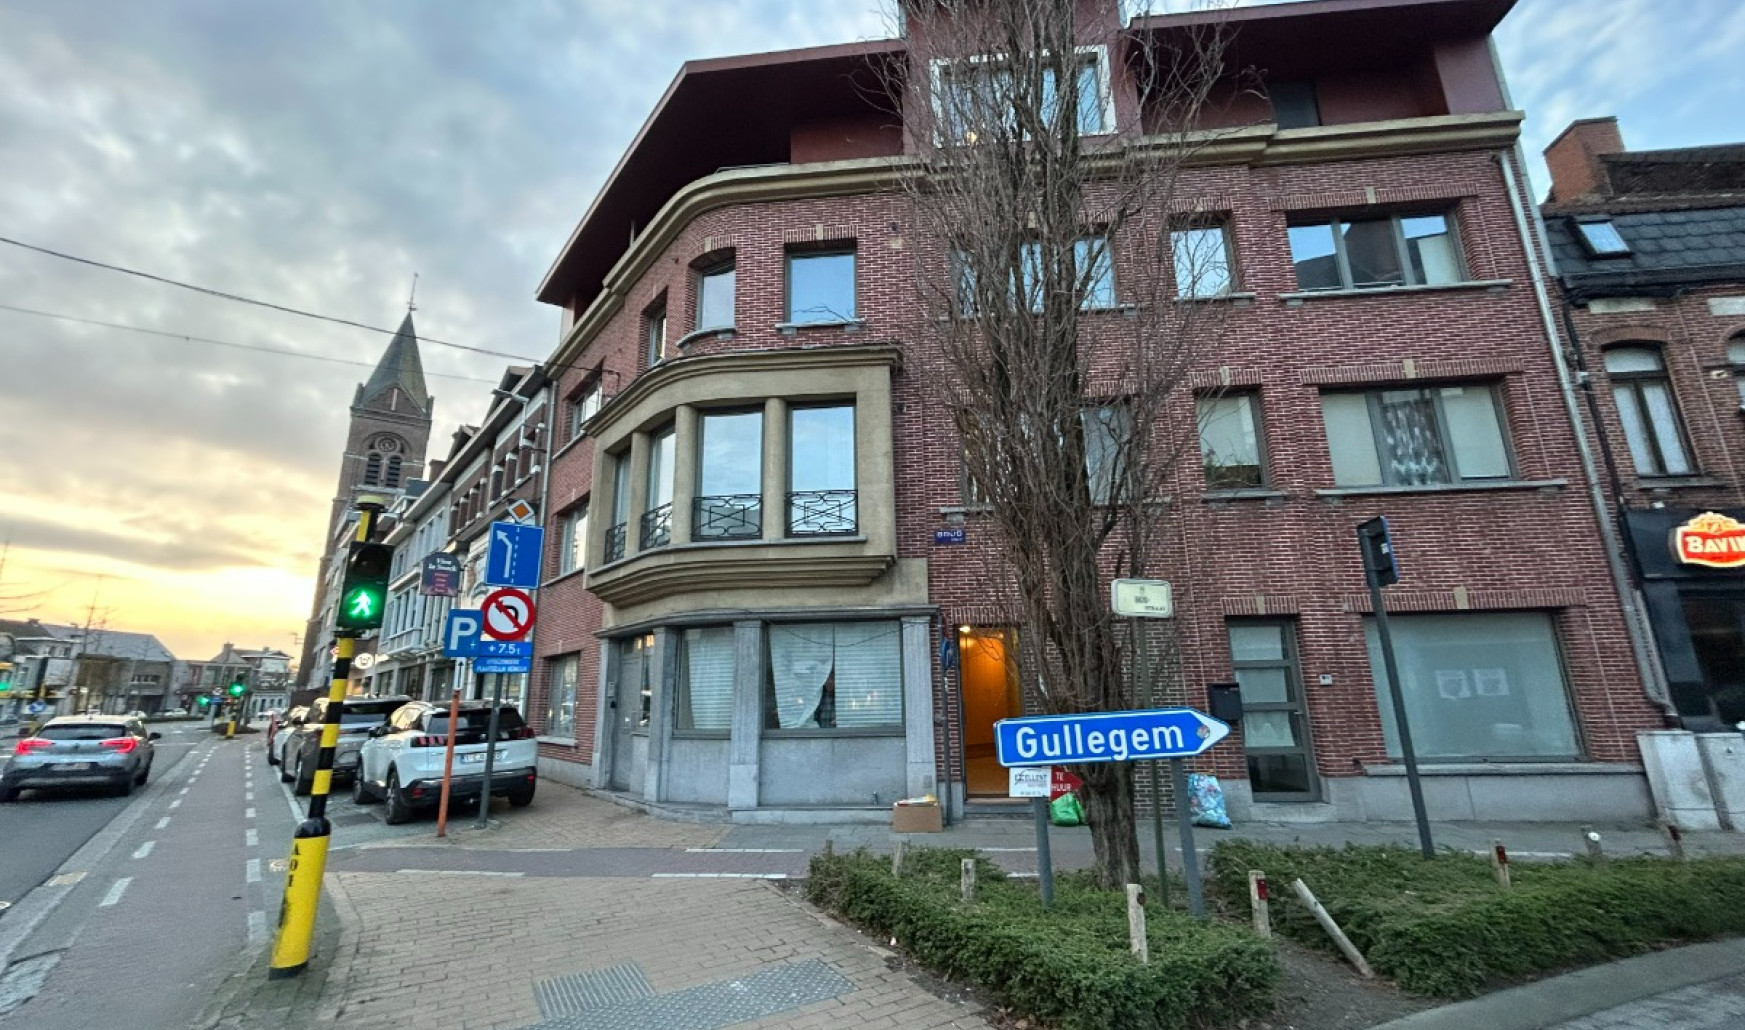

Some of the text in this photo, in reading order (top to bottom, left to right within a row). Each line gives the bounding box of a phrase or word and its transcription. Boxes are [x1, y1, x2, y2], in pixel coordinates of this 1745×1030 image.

[449, 617, 477, 651] P
[1016, 723, 1184, 761] Gullegem
[1056, 771, 1064, 782] TE
